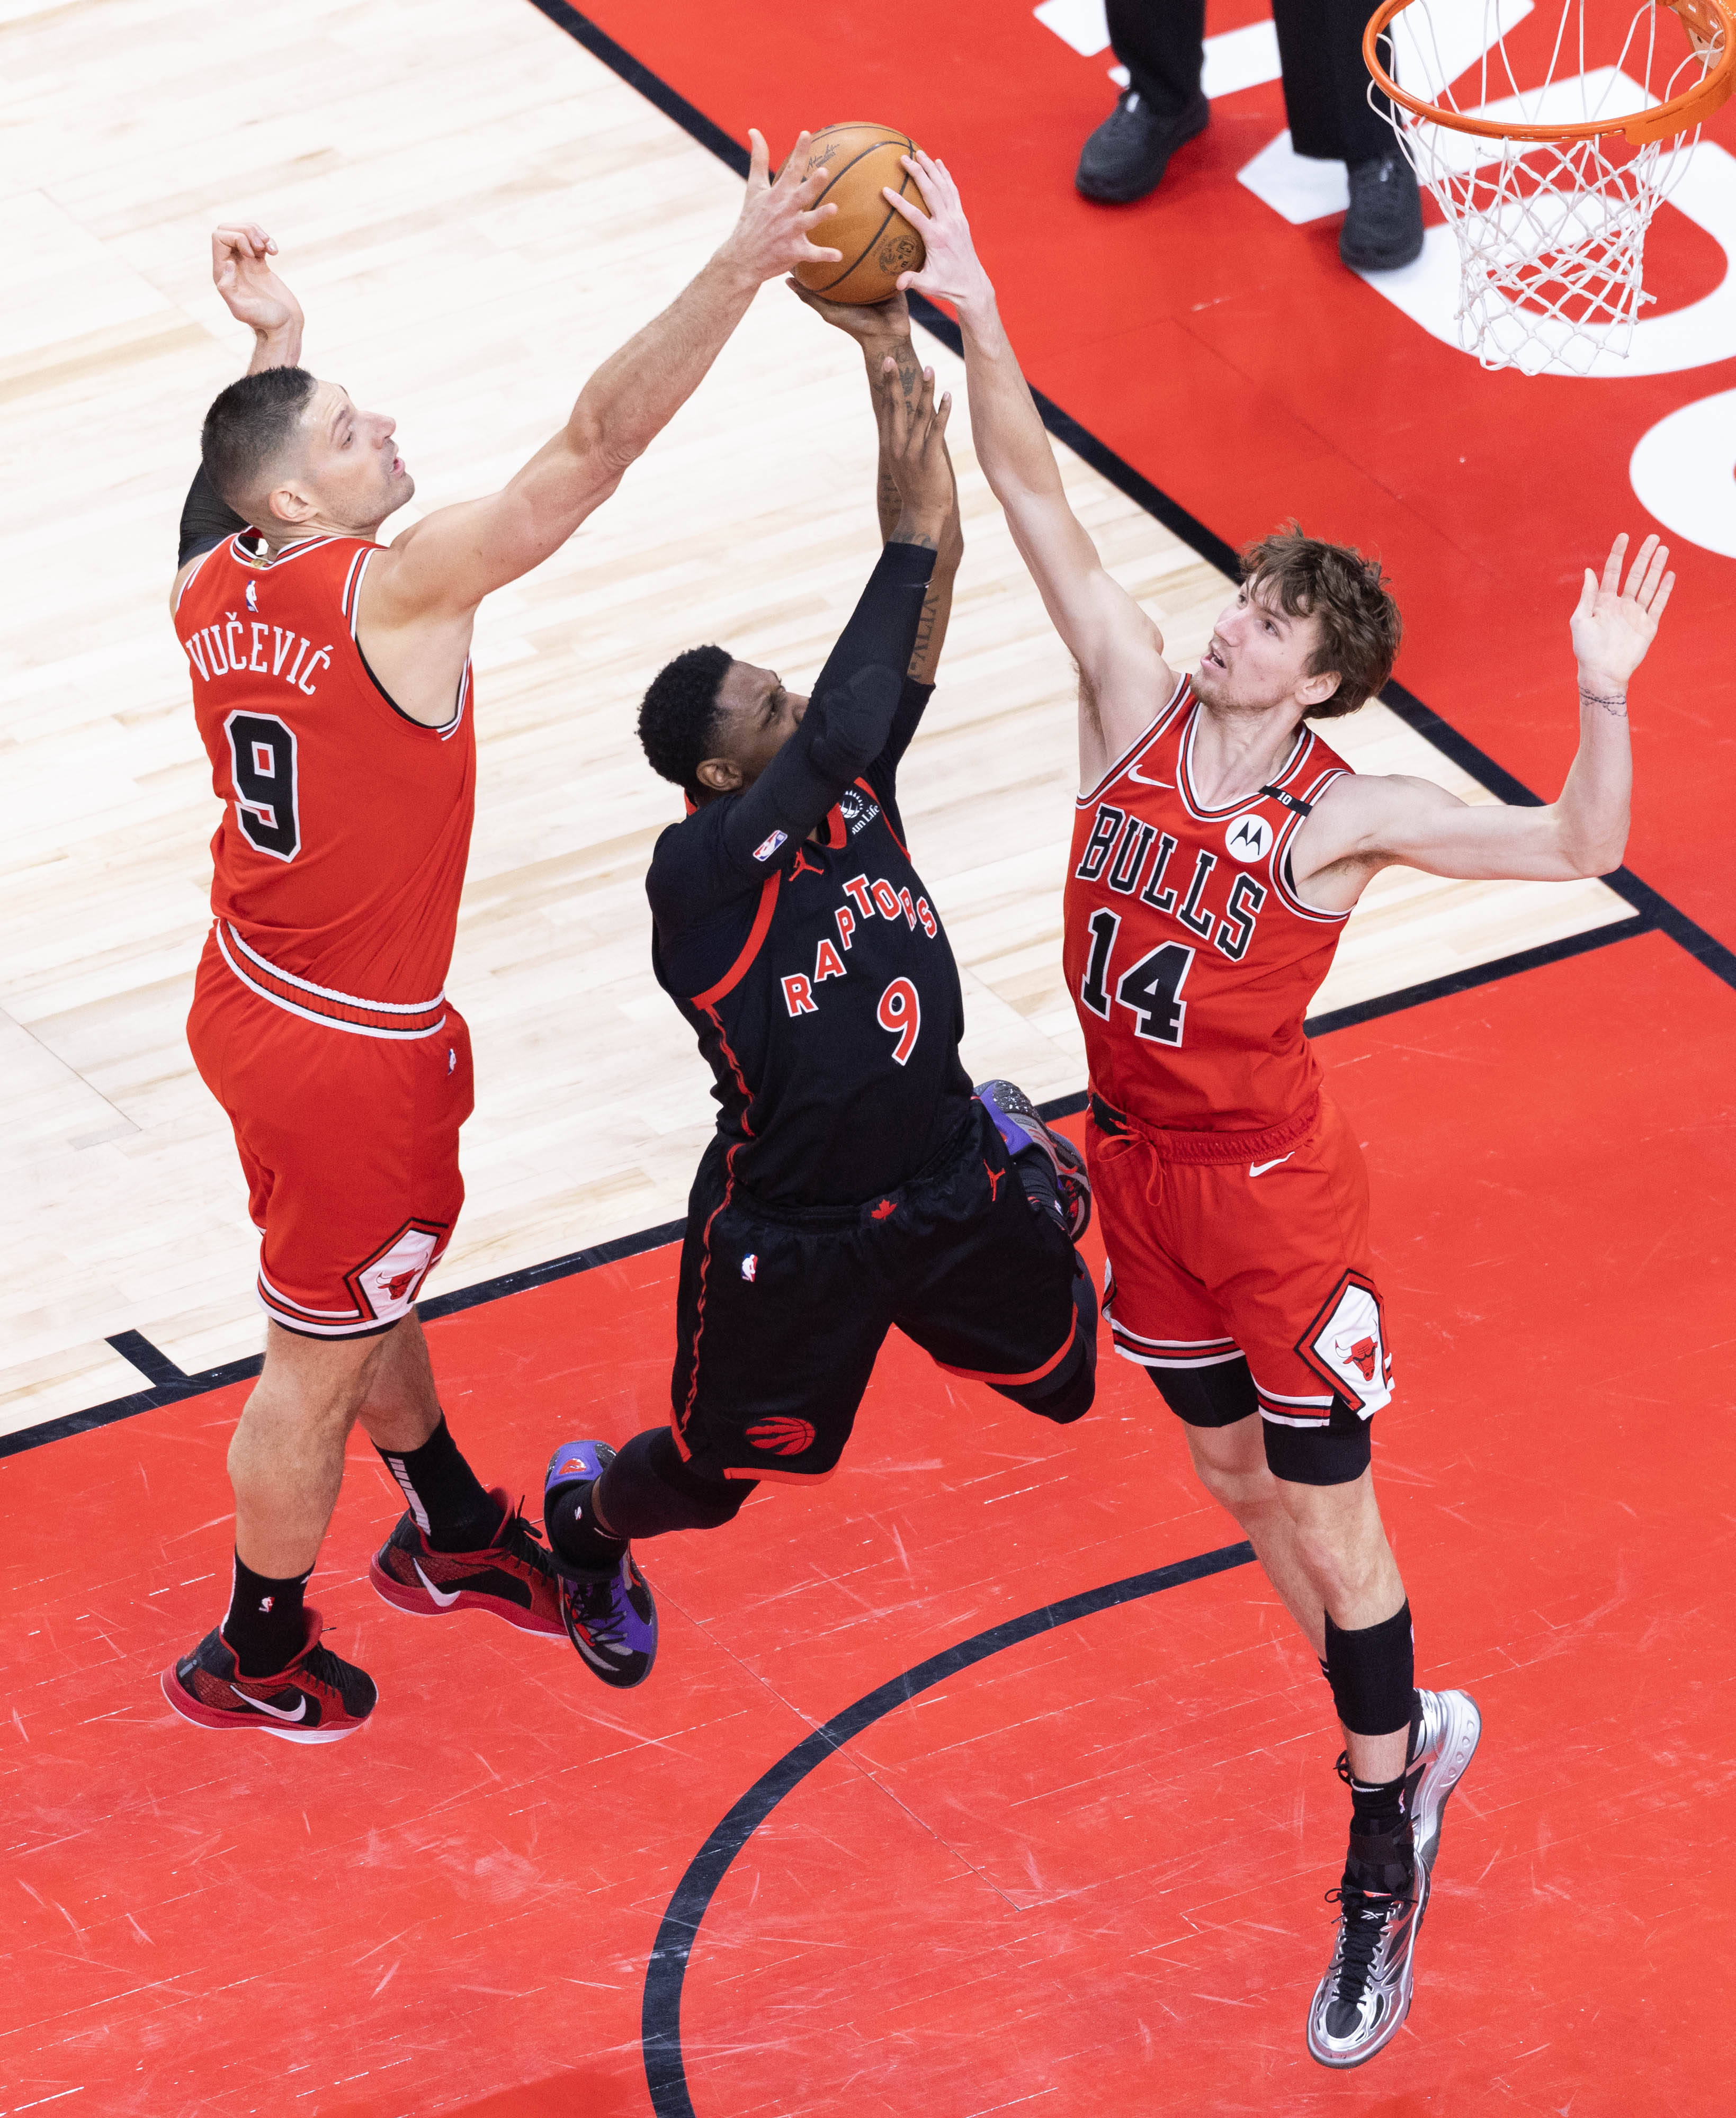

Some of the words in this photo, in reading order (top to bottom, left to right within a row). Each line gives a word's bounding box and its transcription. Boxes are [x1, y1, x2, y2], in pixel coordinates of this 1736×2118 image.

[185, 612, 334, 695] VUČEVIĆ
[223, 709, 301, 863] 9
[862, 805, 880, 822] Life
[1277, 792, 1292, 805] 10
[1075, 803, 1268, 962] BULLS
[781, 873, 937, 1017] RAPTORS
[1080, 907, 1196, 1047] 14
[877, 976, 921, 1066] 9
